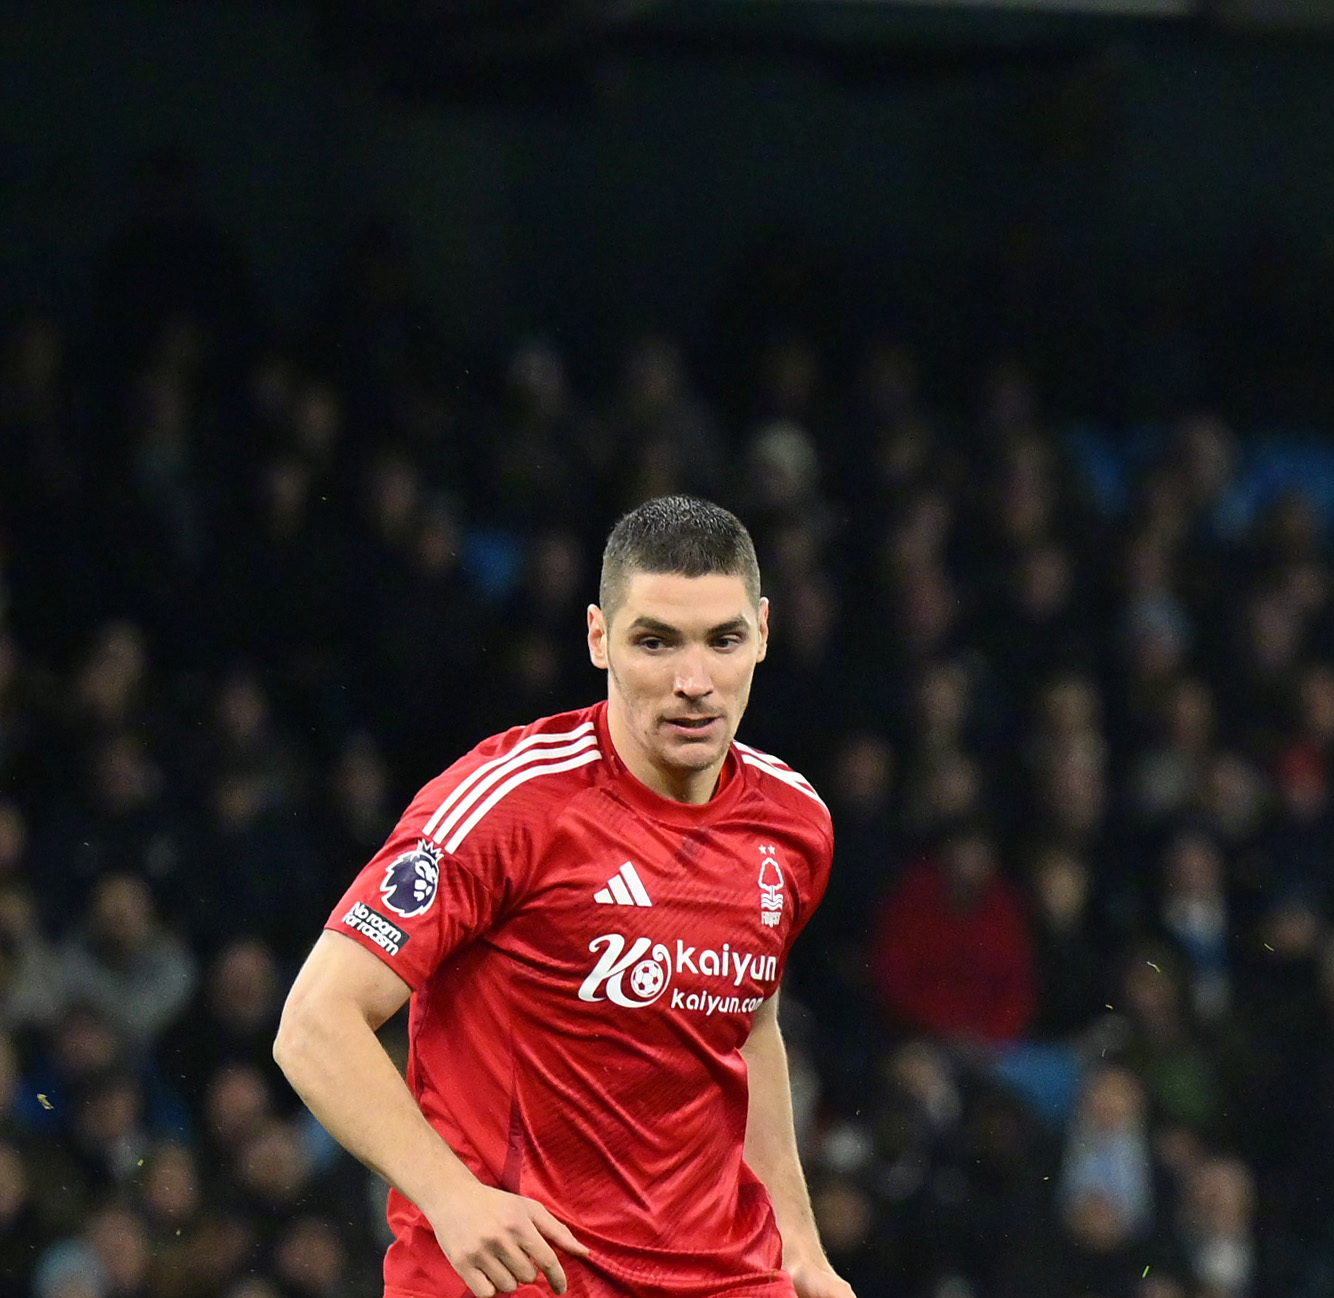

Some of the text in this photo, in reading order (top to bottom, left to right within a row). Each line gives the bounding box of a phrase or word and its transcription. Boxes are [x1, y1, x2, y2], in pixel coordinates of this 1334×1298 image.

[349, 901, 402, 943] No room
[356, 921, 399, 956] racism
